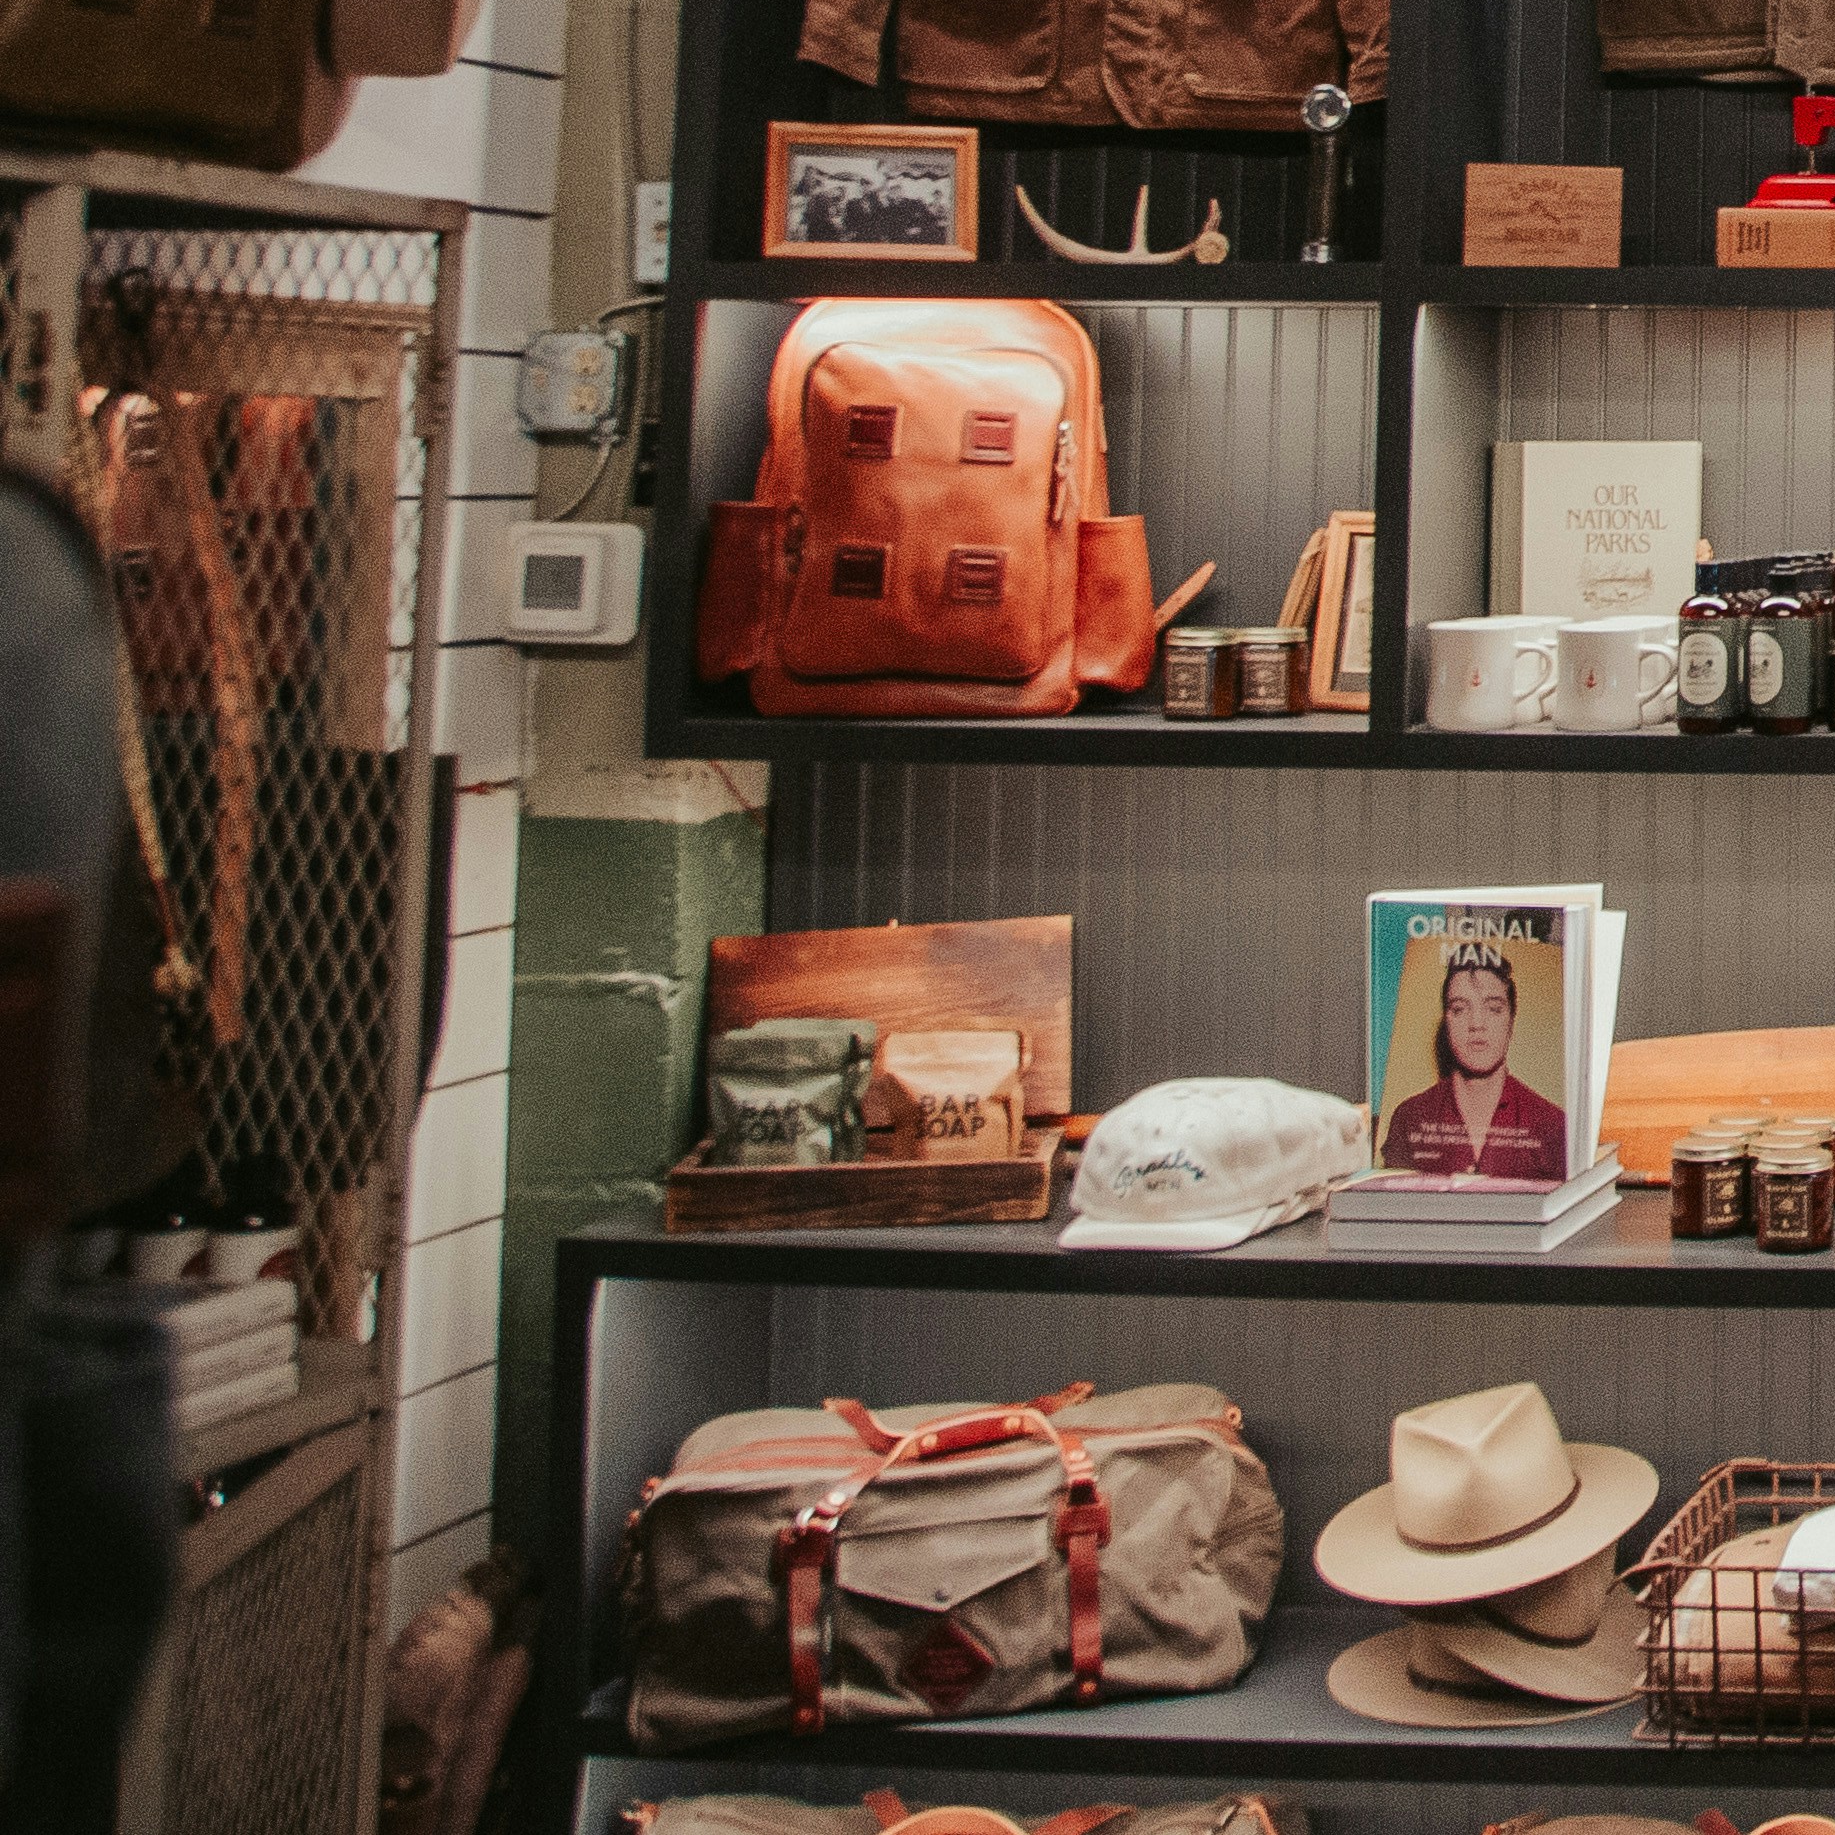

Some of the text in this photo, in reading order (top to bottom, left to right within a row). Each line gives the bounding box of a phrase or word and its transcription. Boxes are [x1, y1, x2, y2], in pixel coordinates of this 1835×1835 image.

[1594, 485, 1640, 506] OUR
[1566, 508, 1668, 530] NATIONAL
[1585, 533, 1652, 554] PARKS
[1407, 914, 1540, 943] ORIGINAL
[1440, 942, 1502, 967] MAN
[920, 1094, 981, 1117] BAR
